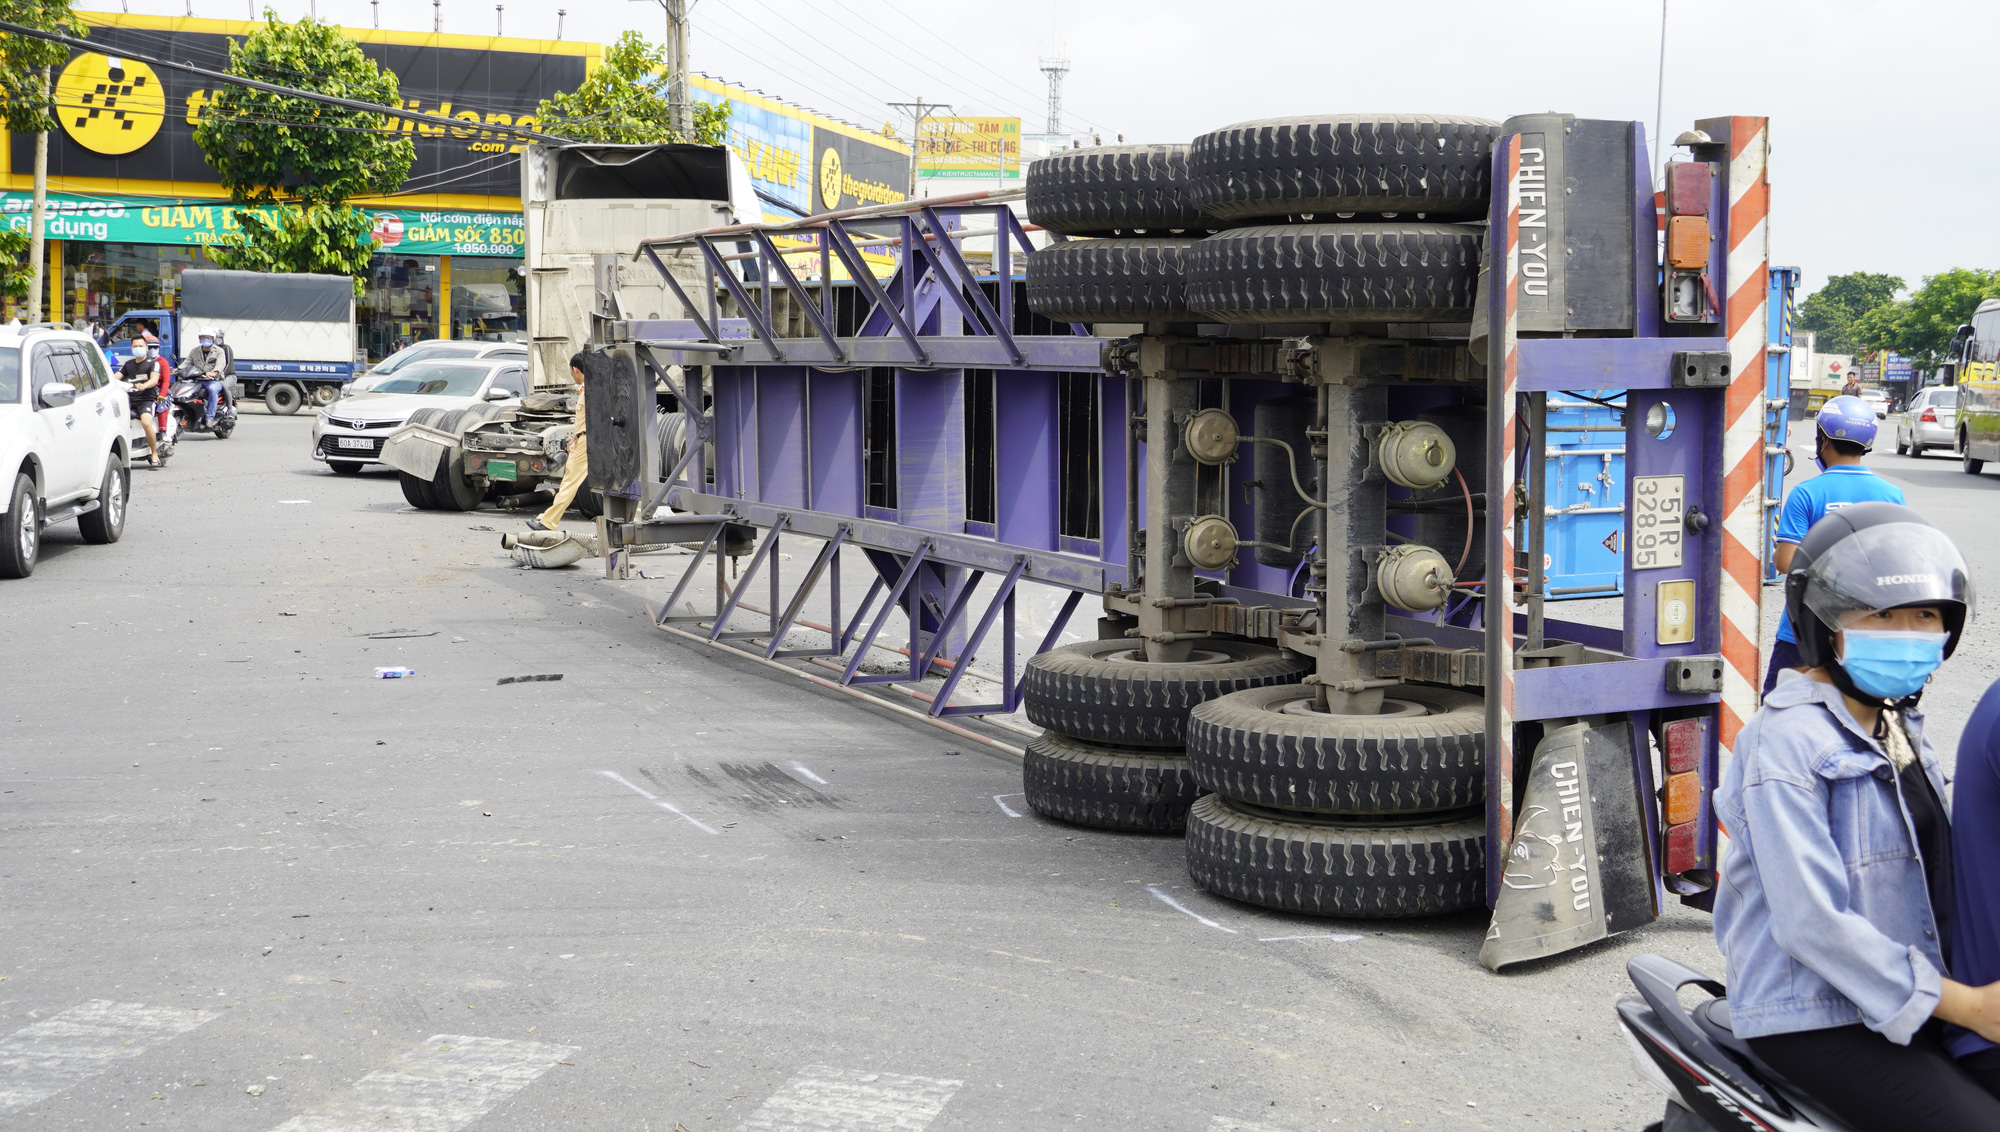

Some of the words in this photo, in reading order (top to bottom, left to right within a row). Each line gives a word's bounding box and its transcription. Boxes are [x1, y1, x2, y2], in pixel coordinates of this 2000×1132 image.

[978, 121, 999, 133] TÂM
[1003, 123, 1016, 133] AN
[467, 141, 505, 153] .com
[972, 140, 987, 152] THI
[746, 139, 800, 188] XANH
[0, 192, 127, 220] angaroo
[141, 199, 215, 231] GIẢM
[51, 217, 108, 240] dụng
[420, 212, 441, 223] Nồi
[443, 214, 471, 224] cơm
[473, 212, 501, 226] điện
[193, 229, 218, 244] TRẢ
[407, 224, 451, 242] GIẢM
[454, 224, 486, 243] SỐC
[454, 243, 515, 254] 1.050.000
[1636, 480, 1658, 566] 328.95
[1659, 497, 1681, 545] 51R
[1550, 761, 1591, 911] CHIEN-YOU
